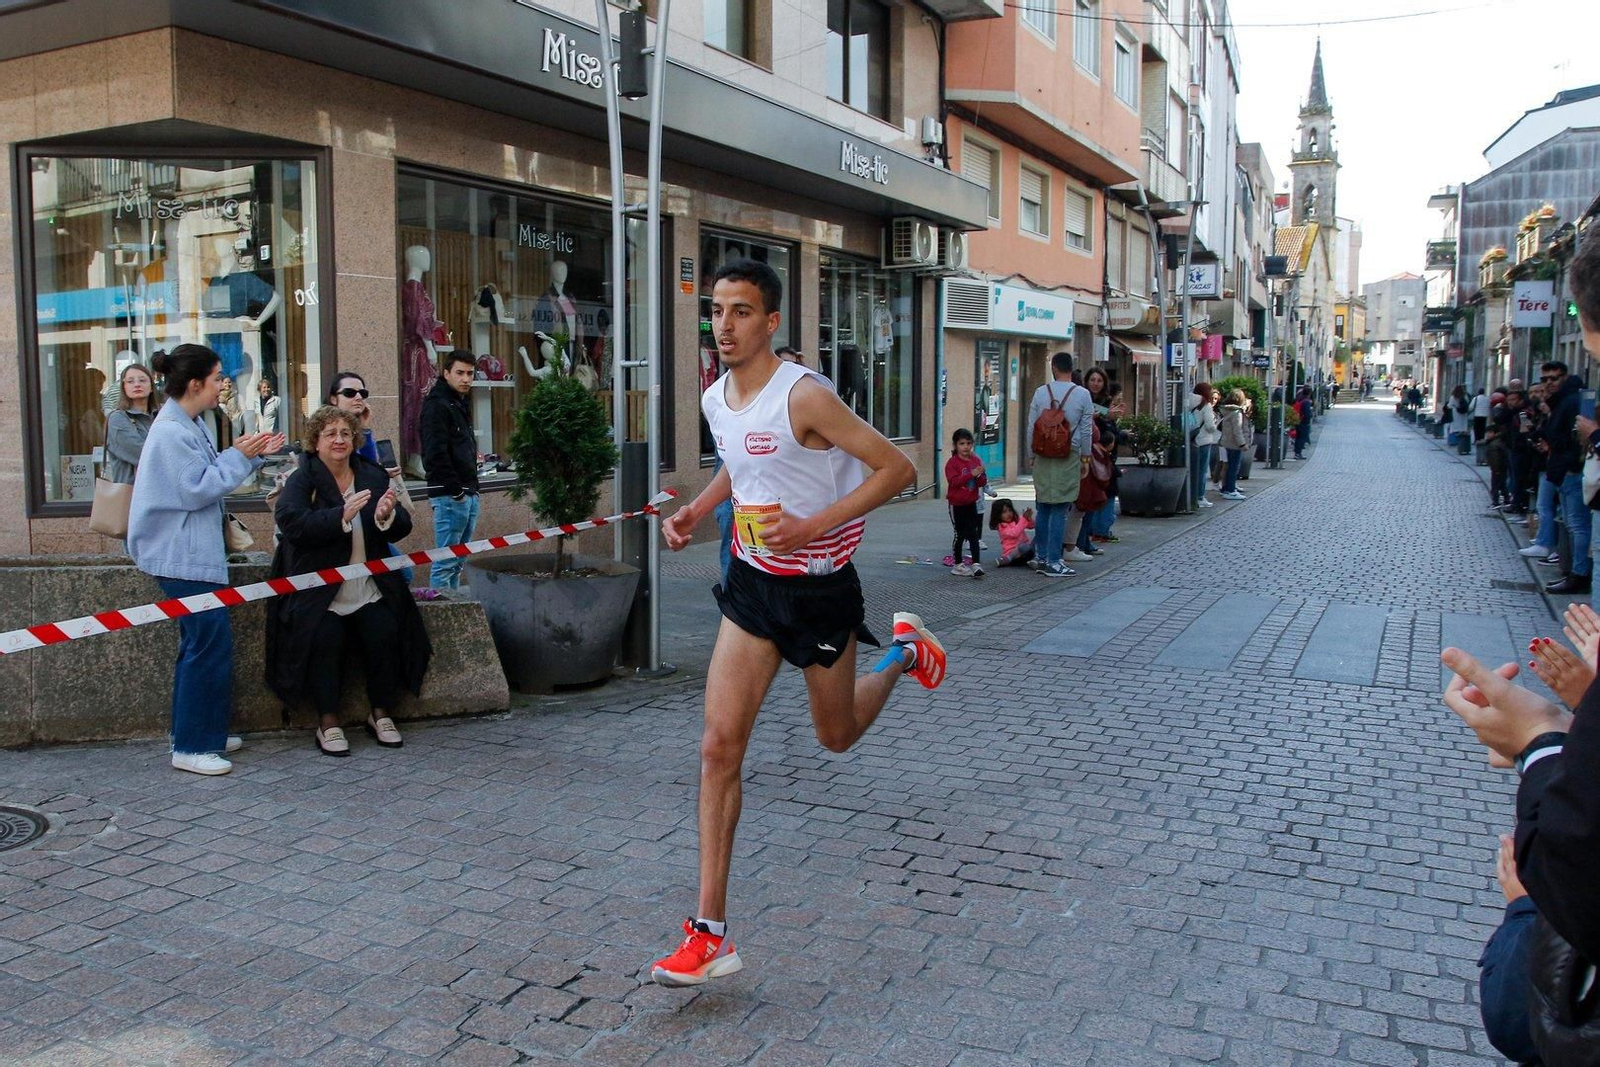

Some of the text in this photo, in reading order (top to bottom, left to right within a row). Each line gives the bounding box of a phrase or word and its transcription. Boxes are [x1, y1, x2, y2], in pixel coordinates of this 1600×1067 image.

[840, 141, 889, 185] Miss-tic
[519, 223, 574, 254] Miss-tic
[1518, 299, 1549, 311] Tere
[747, 523, 756, 546] 1
